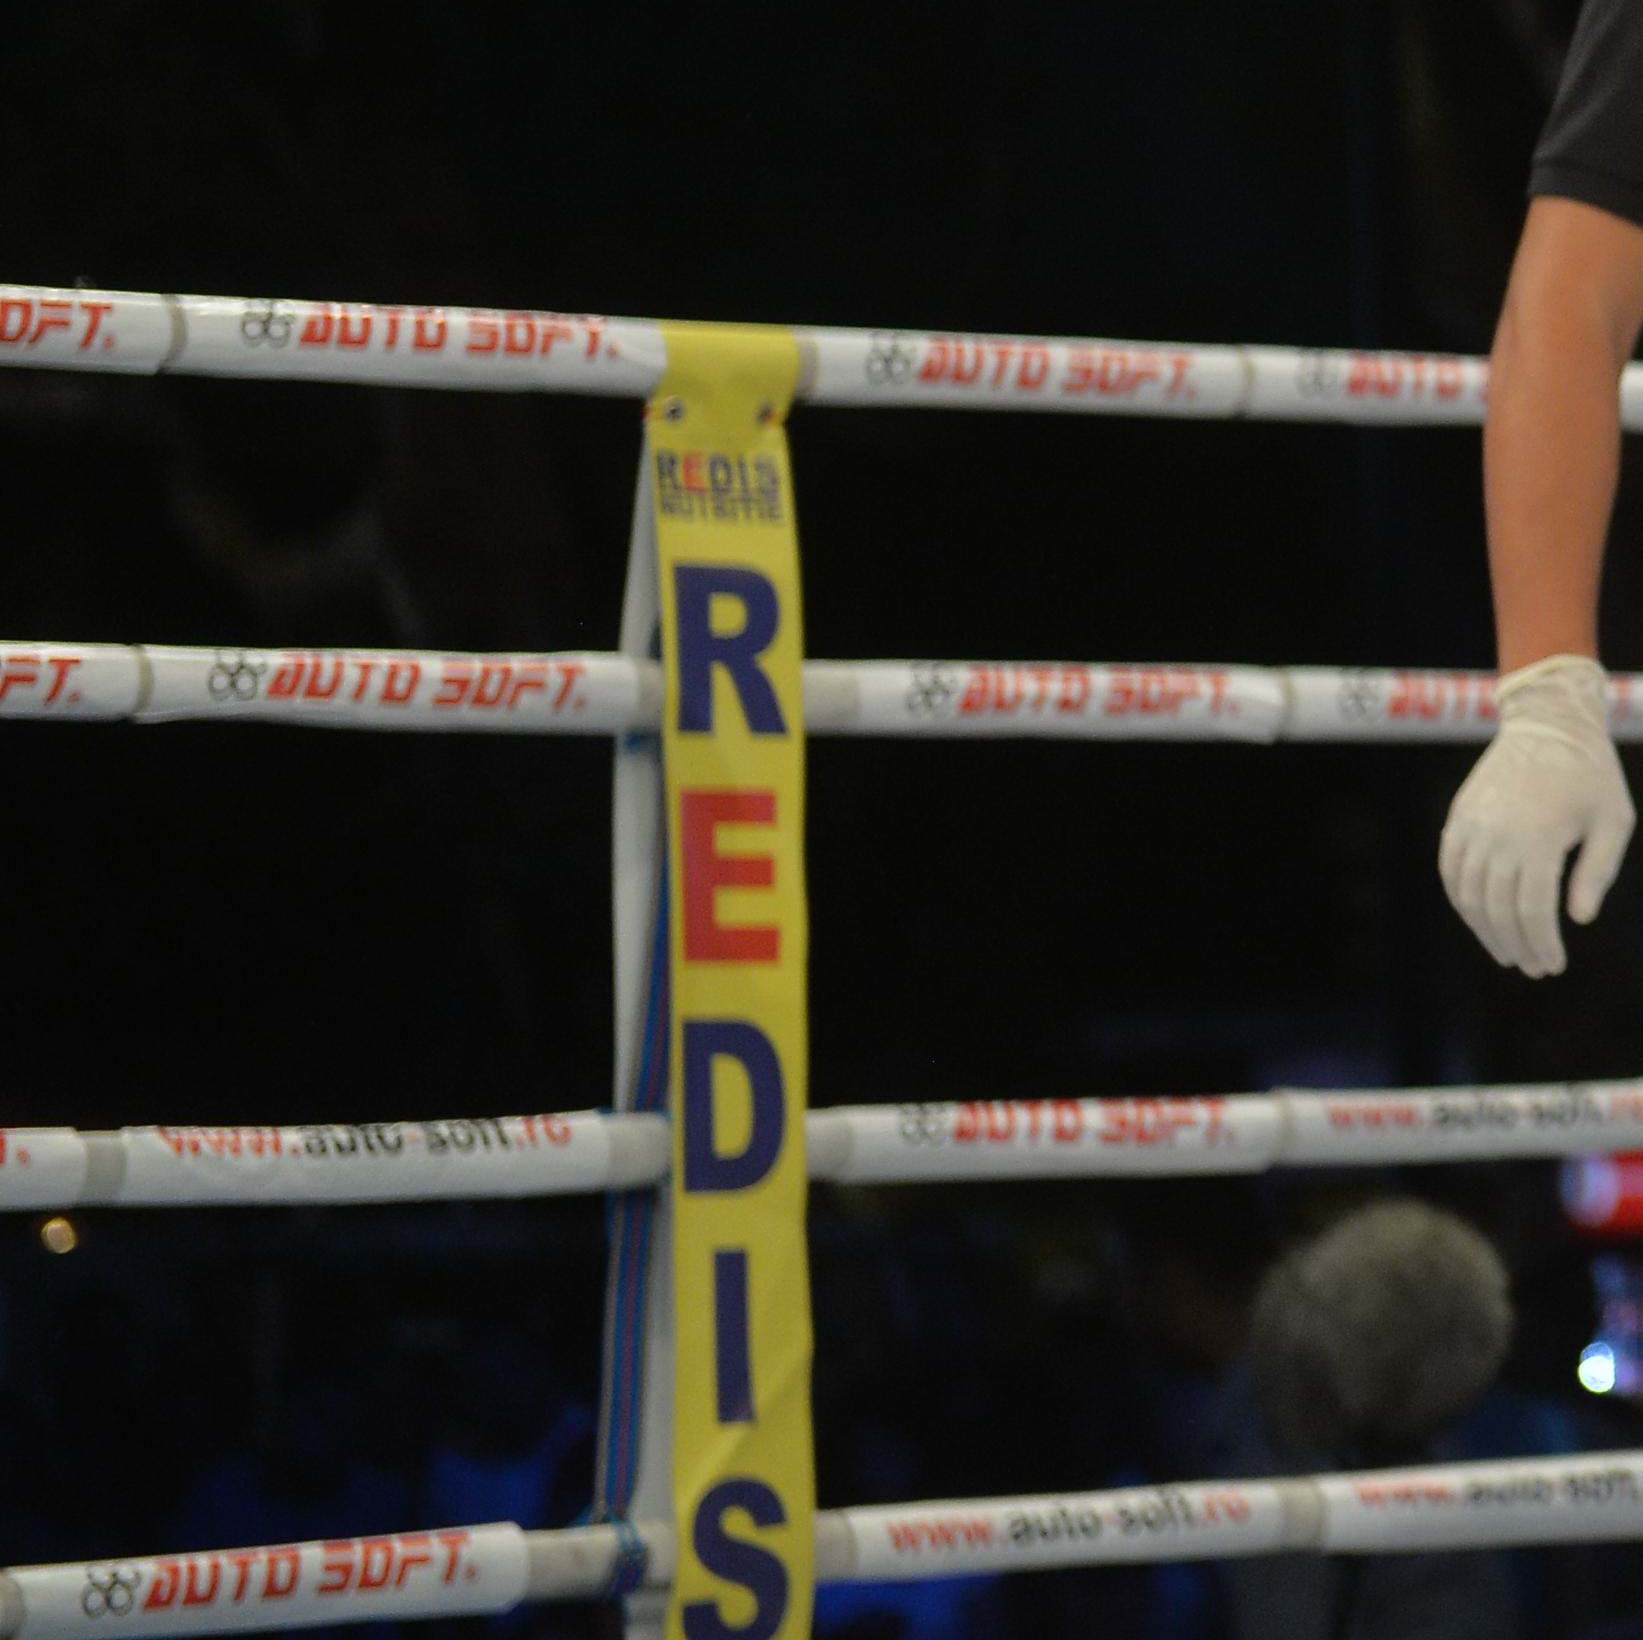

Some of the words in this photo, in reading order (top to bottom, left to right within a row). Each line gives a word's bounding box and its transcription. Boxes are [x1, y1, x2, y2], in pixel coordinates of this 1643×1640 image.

[299, 303, 449, 352] AUTO
[465, 311, 620, 358] SOFT.
[919, 336, 1052, 392] AUTO
[268, 654, 423, 707] AUTO
[430, 657, 588, 713] SOFT.
[959, 664, 1092, 716] AUTO
[674, 564, 790, 1640] REDIS
[954, 1098, 1084, 1147] AUTO
[142, 1545, 301, 1610] AUTO
[317, 1531, 482, 1594] SOFT.
